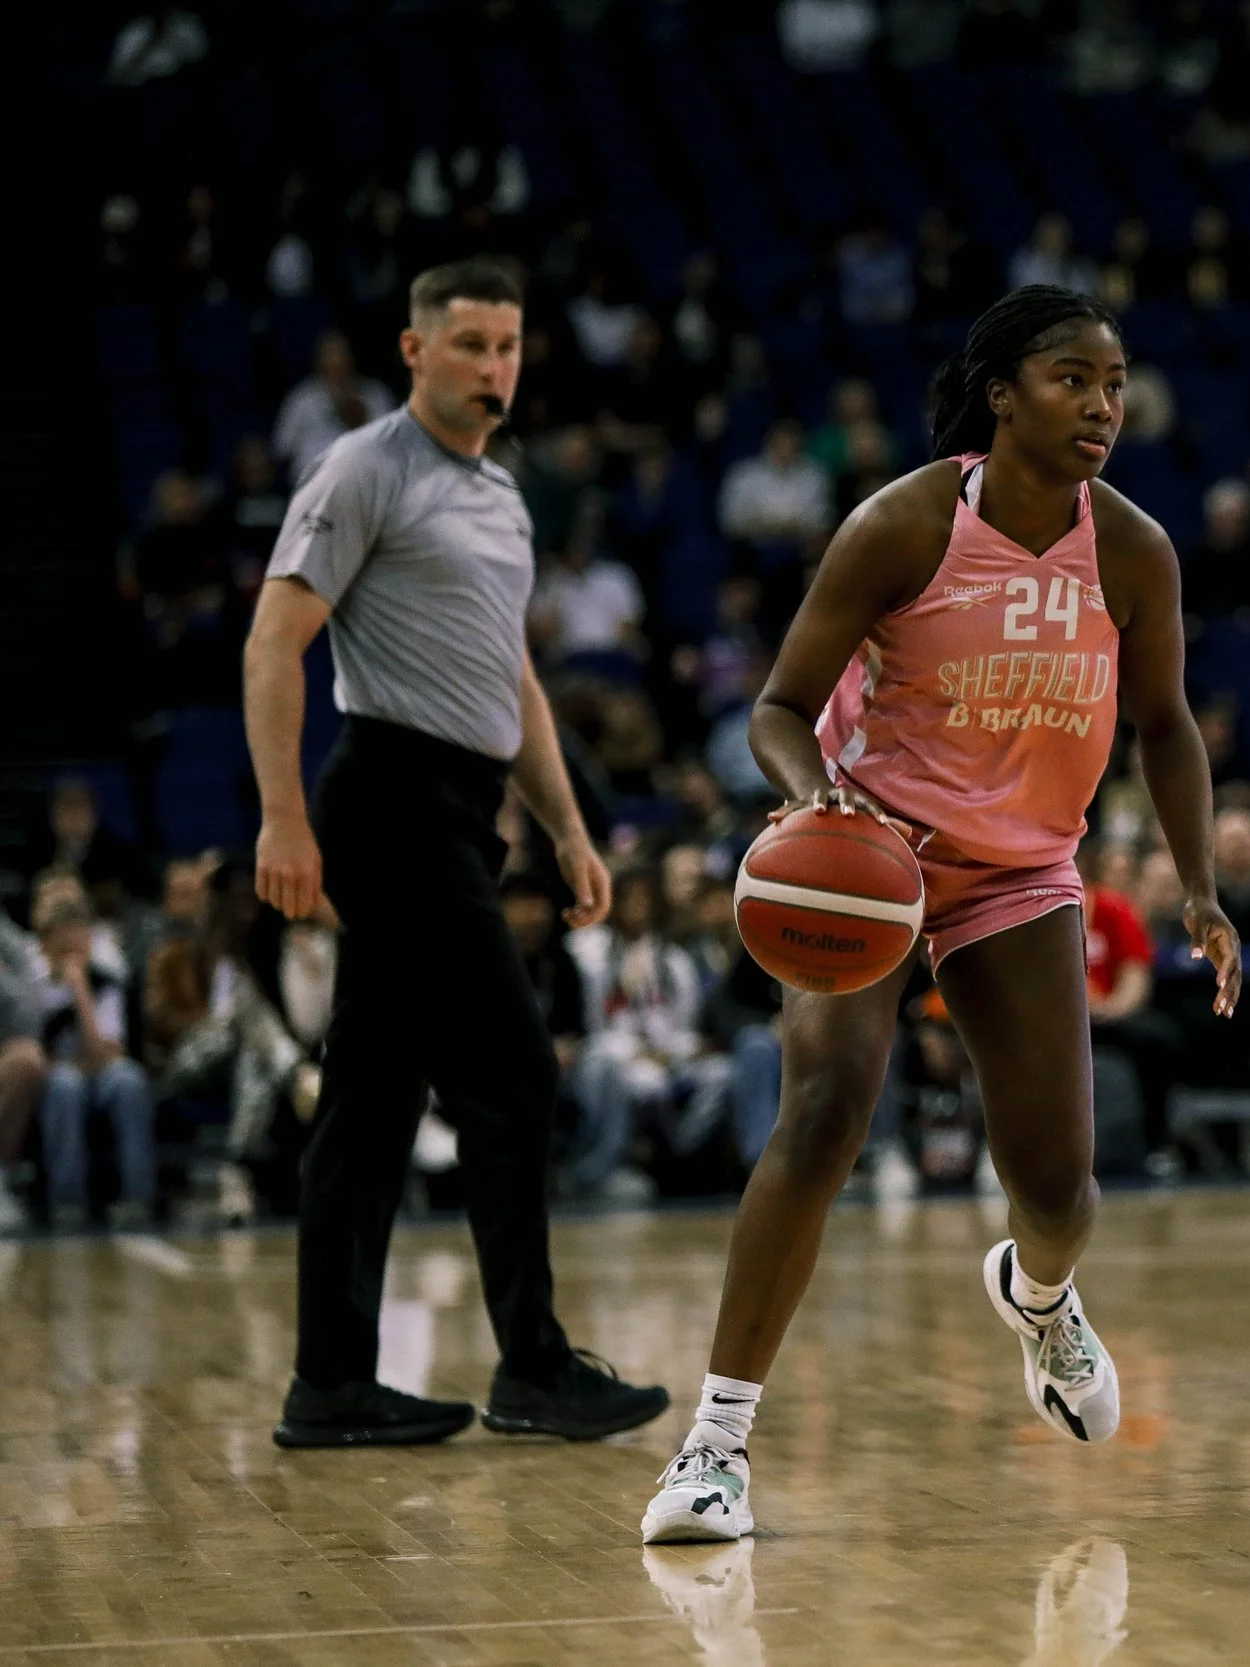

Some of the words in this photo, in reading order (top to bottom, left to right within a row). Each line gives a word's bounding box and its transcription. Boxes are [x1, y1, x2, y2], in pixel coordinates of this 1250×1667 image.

[944, 582, 1002, 598] Reebok
[1003, 577, 1080, 640] 24
[938, 652, 1110, 704] SHEFFIELD
[980, 703, 1092, 738] BRAUN
[781, 927, 866, 954] molten
